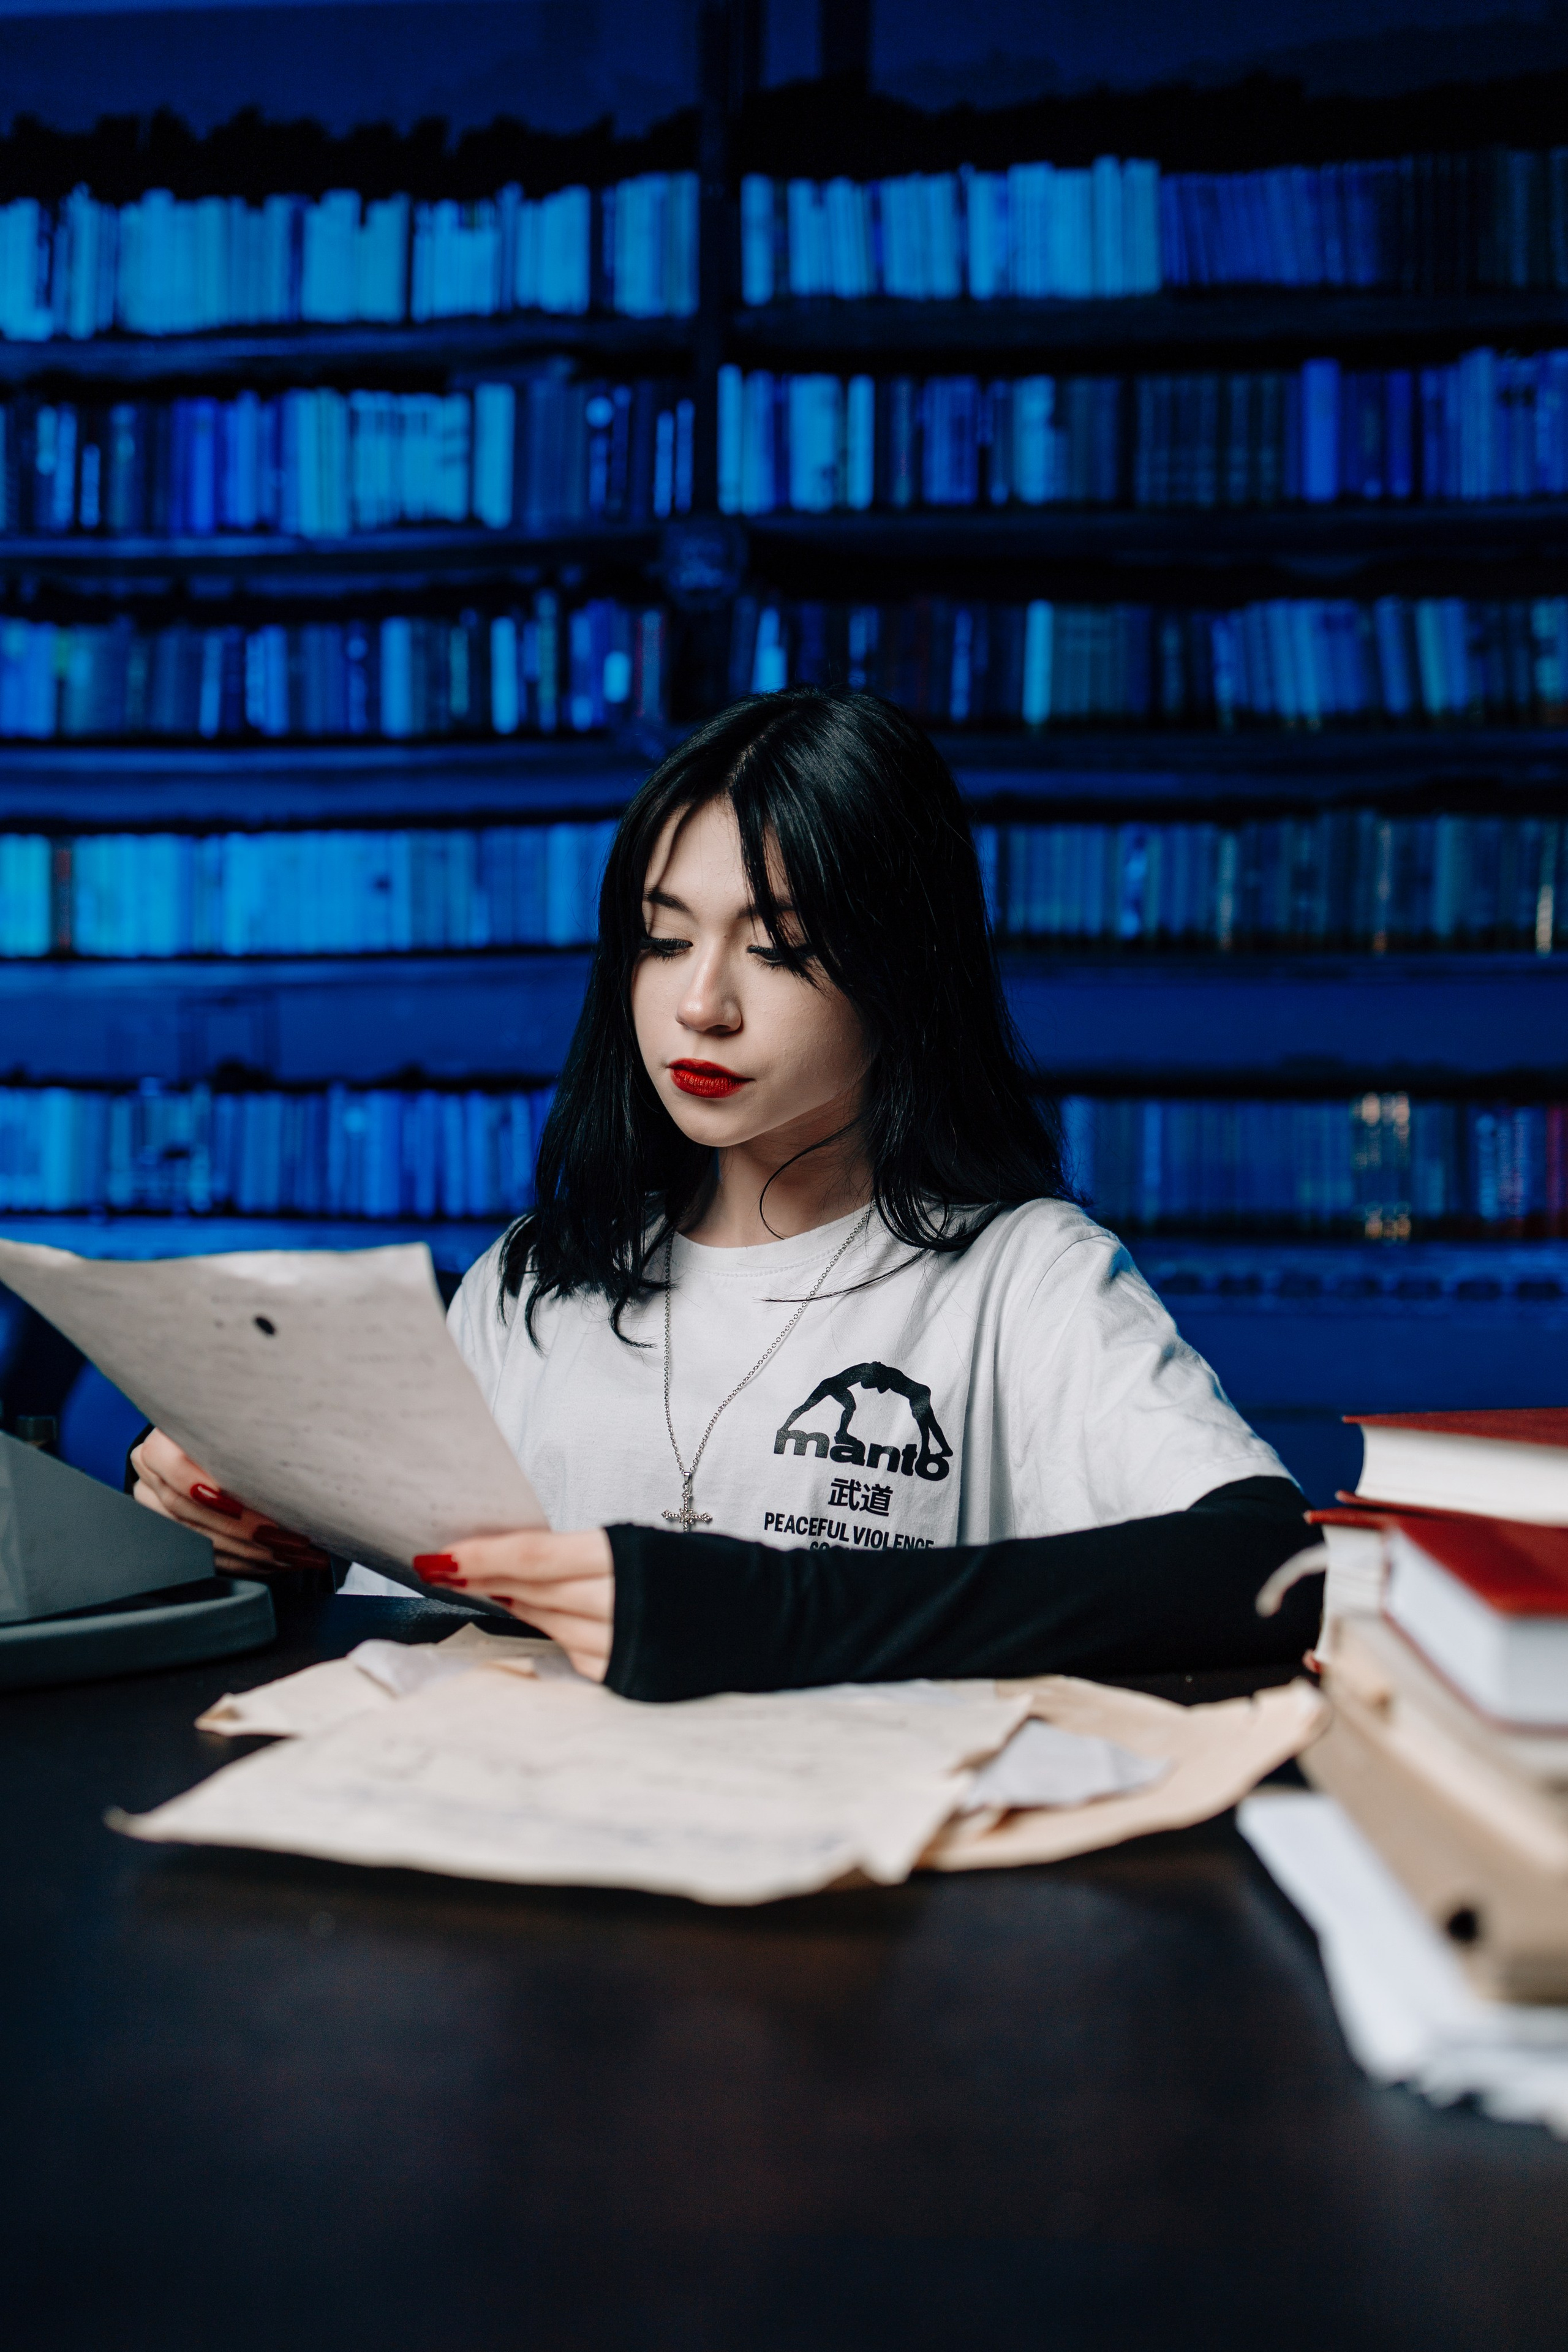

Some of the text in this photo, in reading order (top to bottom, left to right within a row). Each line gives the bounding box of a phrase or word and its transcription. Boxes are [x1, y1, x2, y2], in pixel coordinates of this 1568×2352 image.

[774, 1429, 950, 1482] manto
[827, 1477, 894, 1517] 武道
[764, 1512, 850, 1542] PEACEFUL
